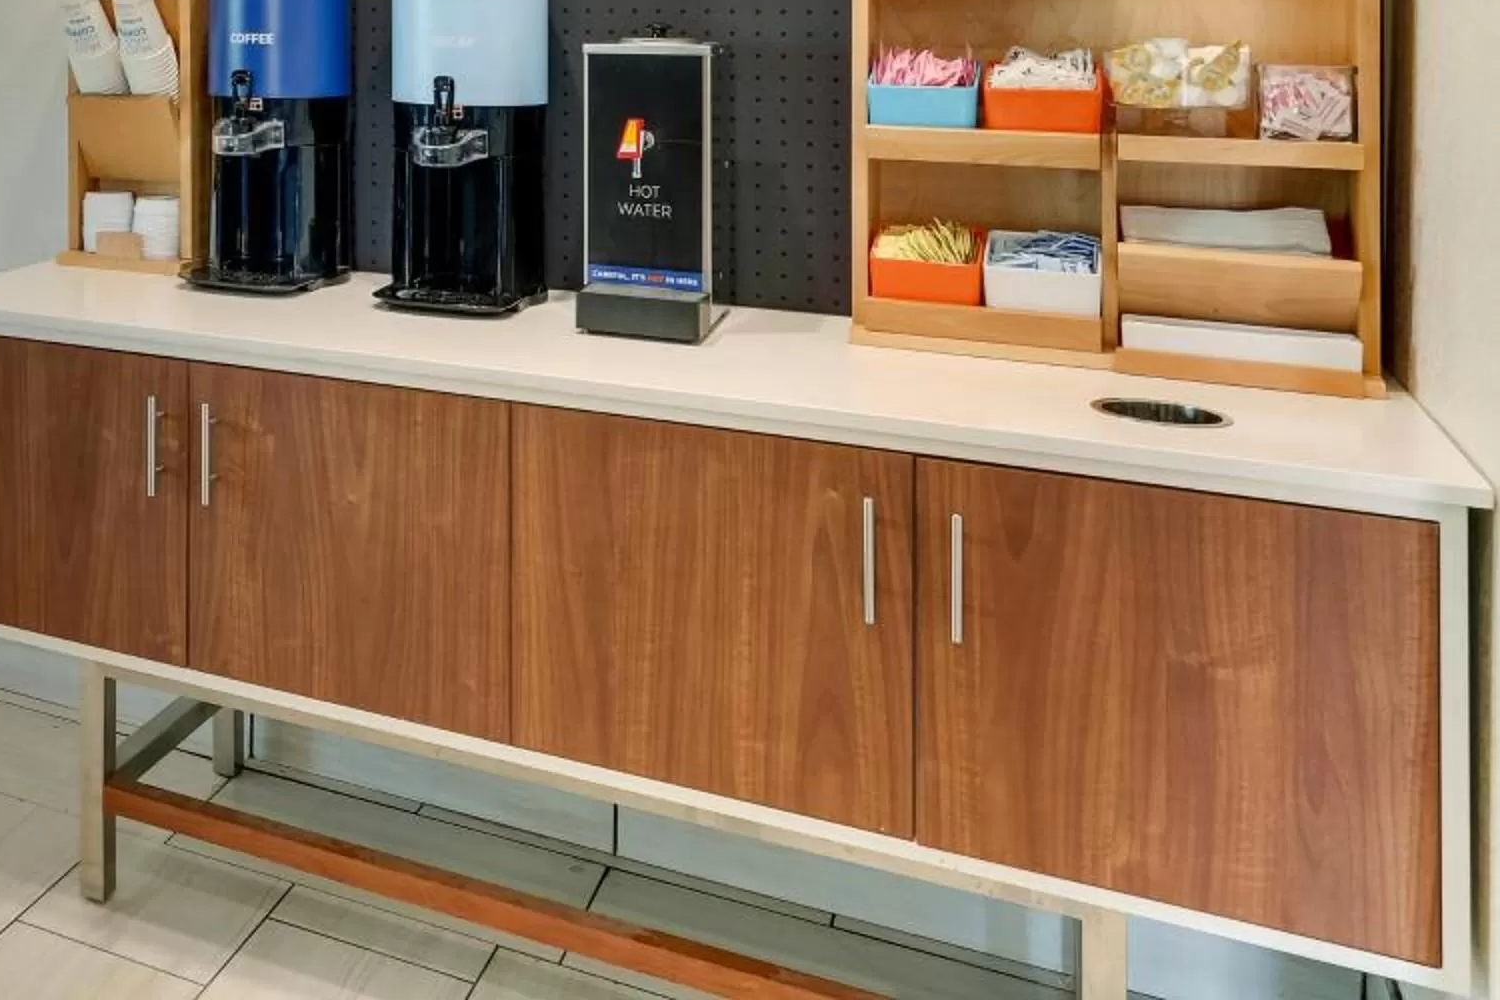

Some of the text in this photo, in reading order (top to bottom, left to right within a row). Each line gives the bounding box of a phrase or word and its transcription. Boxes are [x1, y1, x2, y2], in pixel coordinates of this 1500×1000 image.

[230, 31, 275, 46] COFFEE
[629, 183, 661, 199] HOT
[616, 201, 673, 219] WATER
